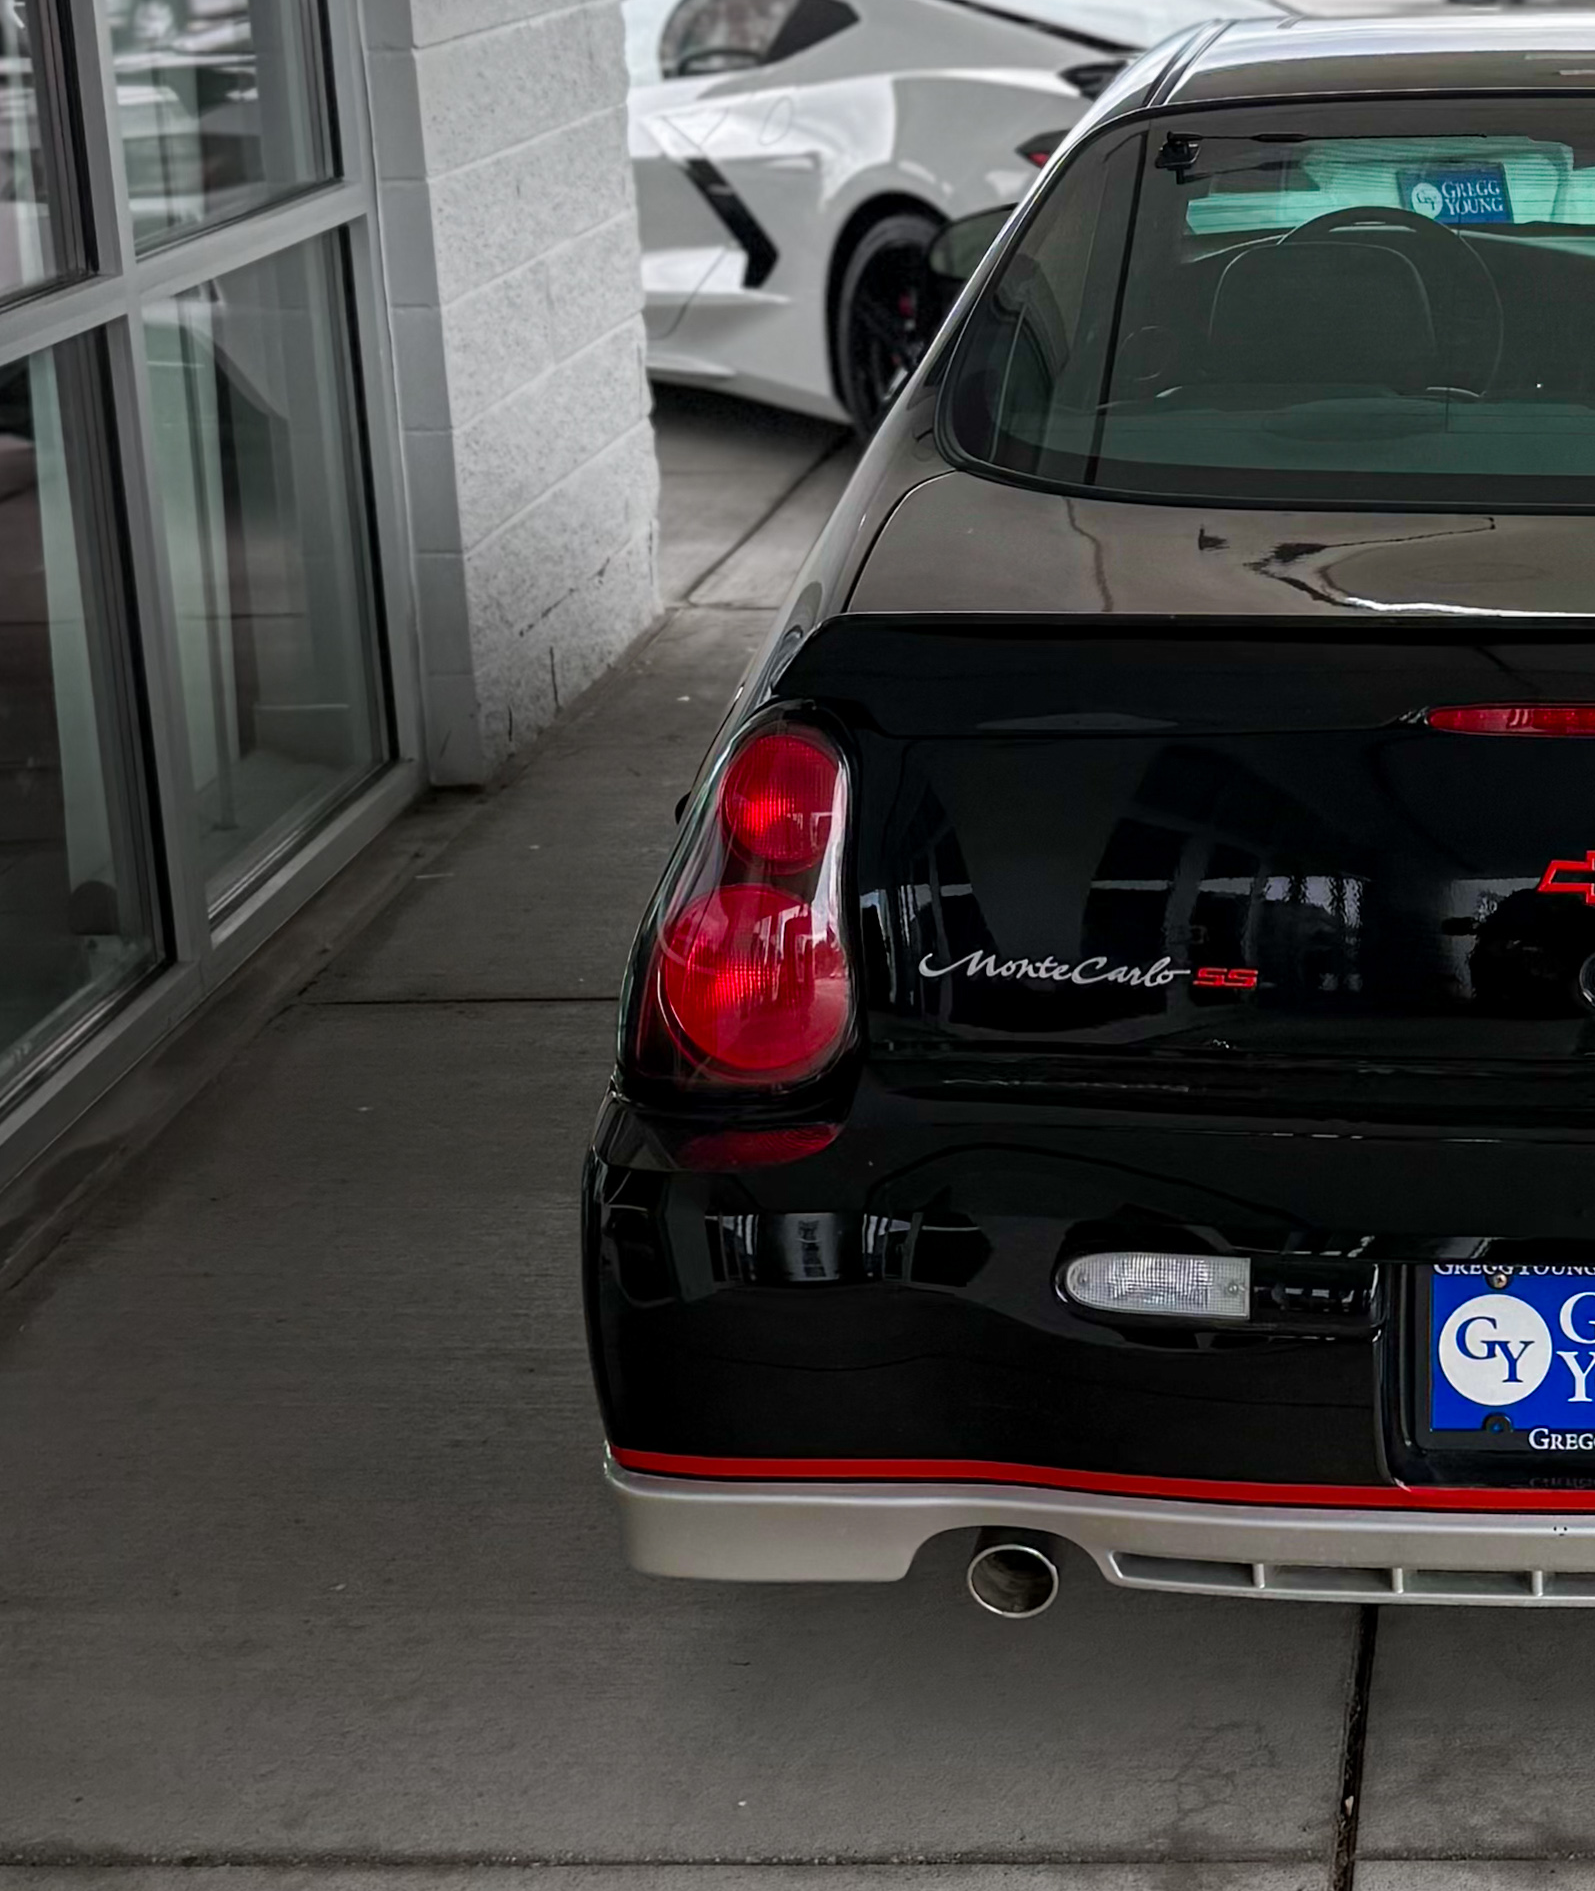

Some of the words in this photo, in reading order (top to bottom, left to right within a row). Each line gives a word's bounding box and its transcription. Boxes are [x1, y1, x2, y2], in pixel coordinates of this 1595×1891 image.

[1441, 180, 1500, 199] GREGG
[1444, 197, 1504, 216] YOUNG
[1193, 967, 1258, 988] SS
